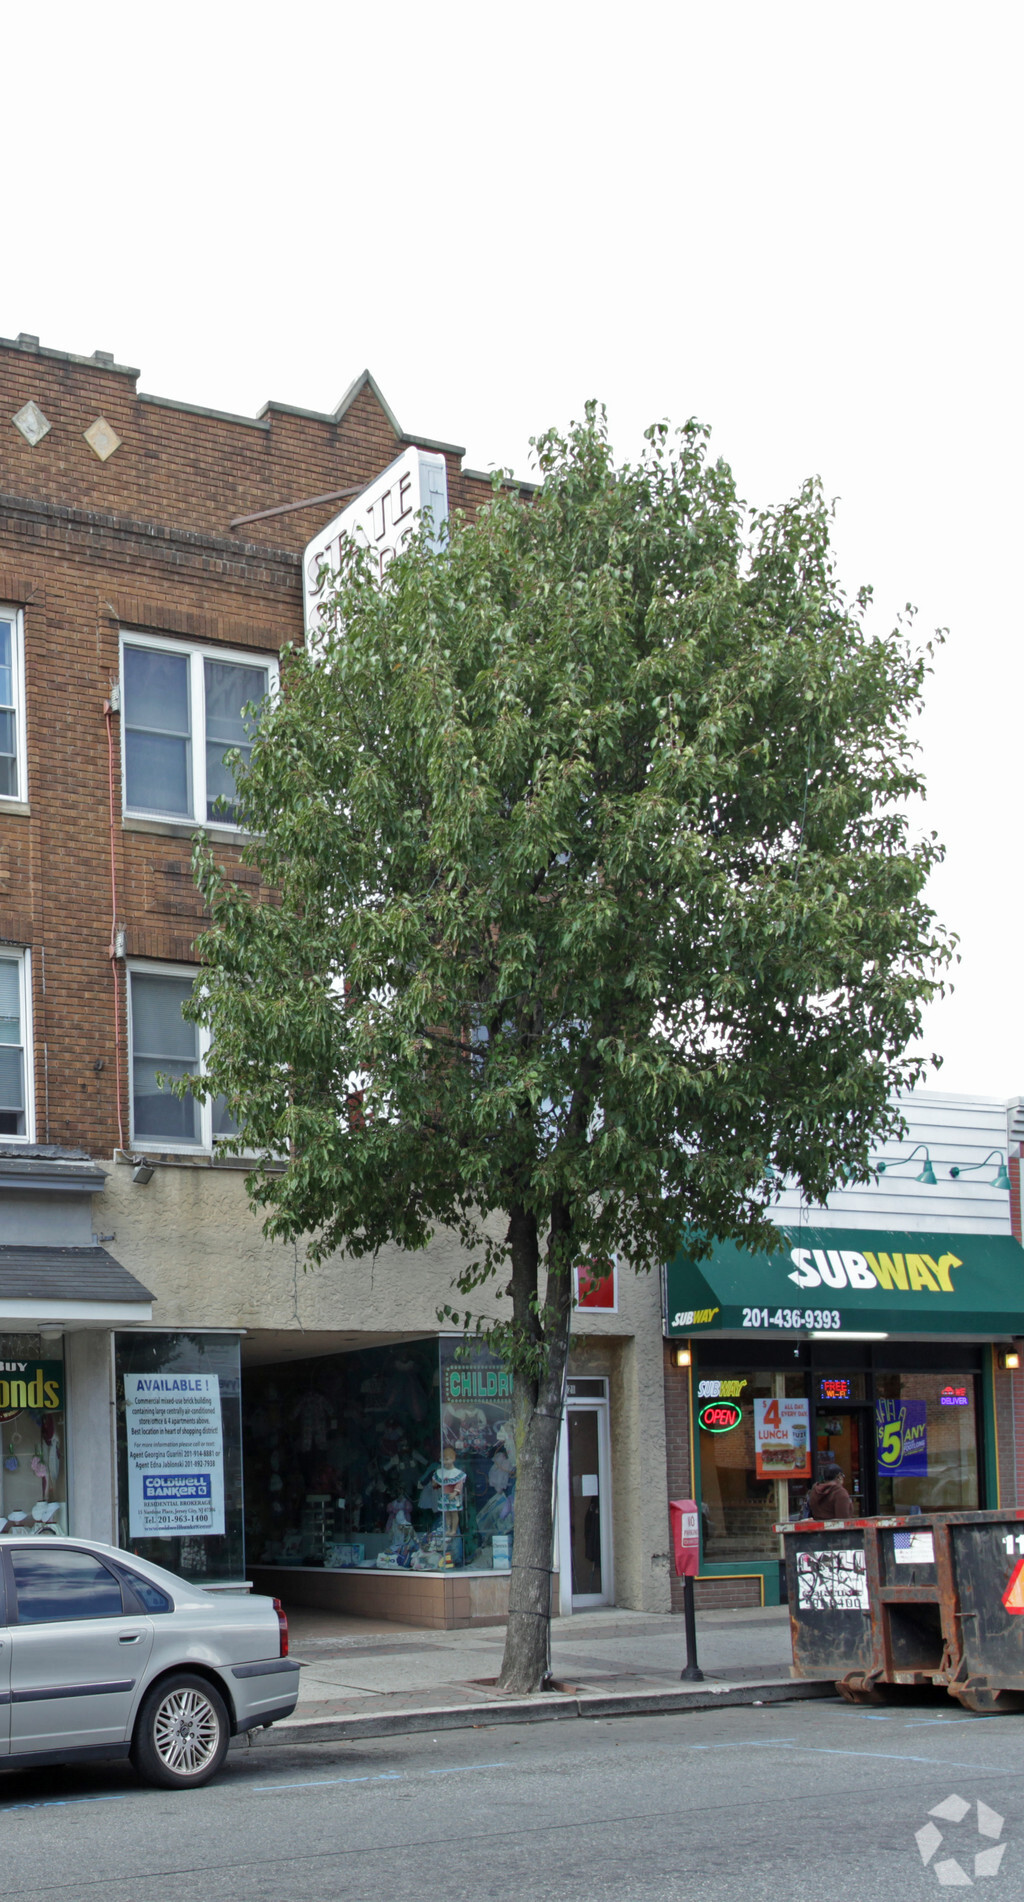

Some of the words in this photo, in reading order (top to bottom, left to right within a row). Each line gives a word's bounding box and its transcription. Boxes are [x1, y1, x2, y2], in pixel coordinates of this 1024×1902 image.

[788, 1247, 963, 1292] SUBWAY
[671, 1307, 720, 1327] SUBWAY
[742, 1307, 841, 1329] 201-436-9393
[136, 1379, 202, 1391] AVAILABLE
[697, 1379, 748, 1398] SUBWAY
[824, 1381, 848, 1392] FREE
[134, 1396, 161, 1405] Commercial
[161, 1397, 183, 1405] mixed-use
[183, 1396, 195, 1405] brick
[194, 1397, 212, 1406] building
[940, 1396, 969, 1405] DELIVER
[131, 1408, 155, 1416] containing
[154, 1408, 167, 1416] large
[166, 1407, 185, 1416] centrally
[184, 1407, 216, 1415] air-conditioned
[703, 1408, 737, 1426] OPEN
[171, 1417, 196, 1426] apartments
[131, 1427, 142, 1436] Best
[141, 1427, 160, 1435] location
[164, 1427, 177, 1435] heart
[176, 1427, 182, 1435] of
[182, 1427, 202, 1437] shopping
[758, 1429, 789, 1440] LUNCH
[903, 1423, 926, 1443] ANY
[129, 1451, 144, 1460] Agent
[144, 1450, 166, 1460] Georgina
[135, 1461, 150, 1470] Agent
[150, 1461, 162, 1469] Edna
[145, 1476, 207, 1487] COLDWELL
[146, 1486, 197, 1497] BANKER
[143, 1500, 179, 1508] RESIDENTIAL
[179, 1499, 212, 1507] BROKERAGE
[174, 1507, 188, 1515] Jersey
[157, 1514, 209, 1523] 201-963-1400
